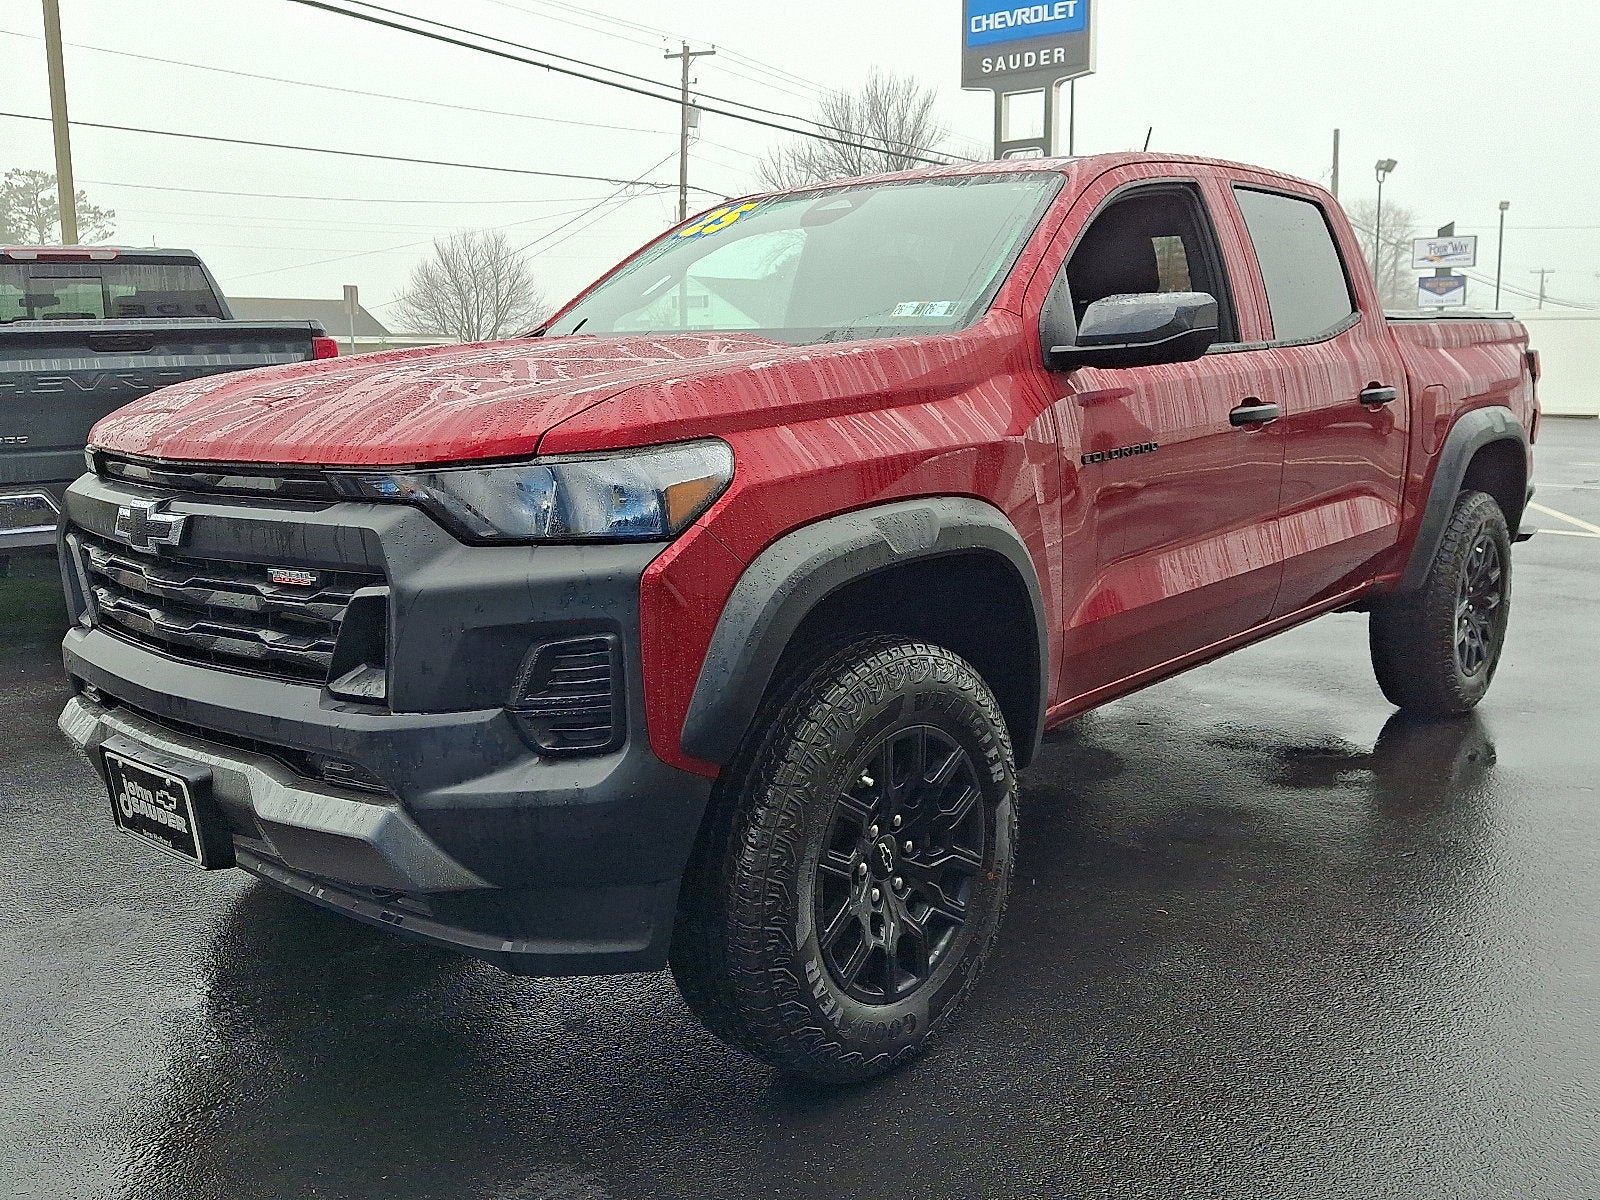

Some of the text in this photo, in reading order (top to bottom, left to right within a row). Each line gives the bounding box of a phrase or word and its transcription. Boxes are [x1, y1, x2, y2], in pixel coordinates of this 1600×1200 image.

[970, 1, 1078, 33] CHEVROLET
[982, 47, 1065, 73] SAUDER
[679, 202, 758, 236] 25
[1081, 441, 1159, 465] COLORADO
[131, 796, 188, 834] SAUDER
